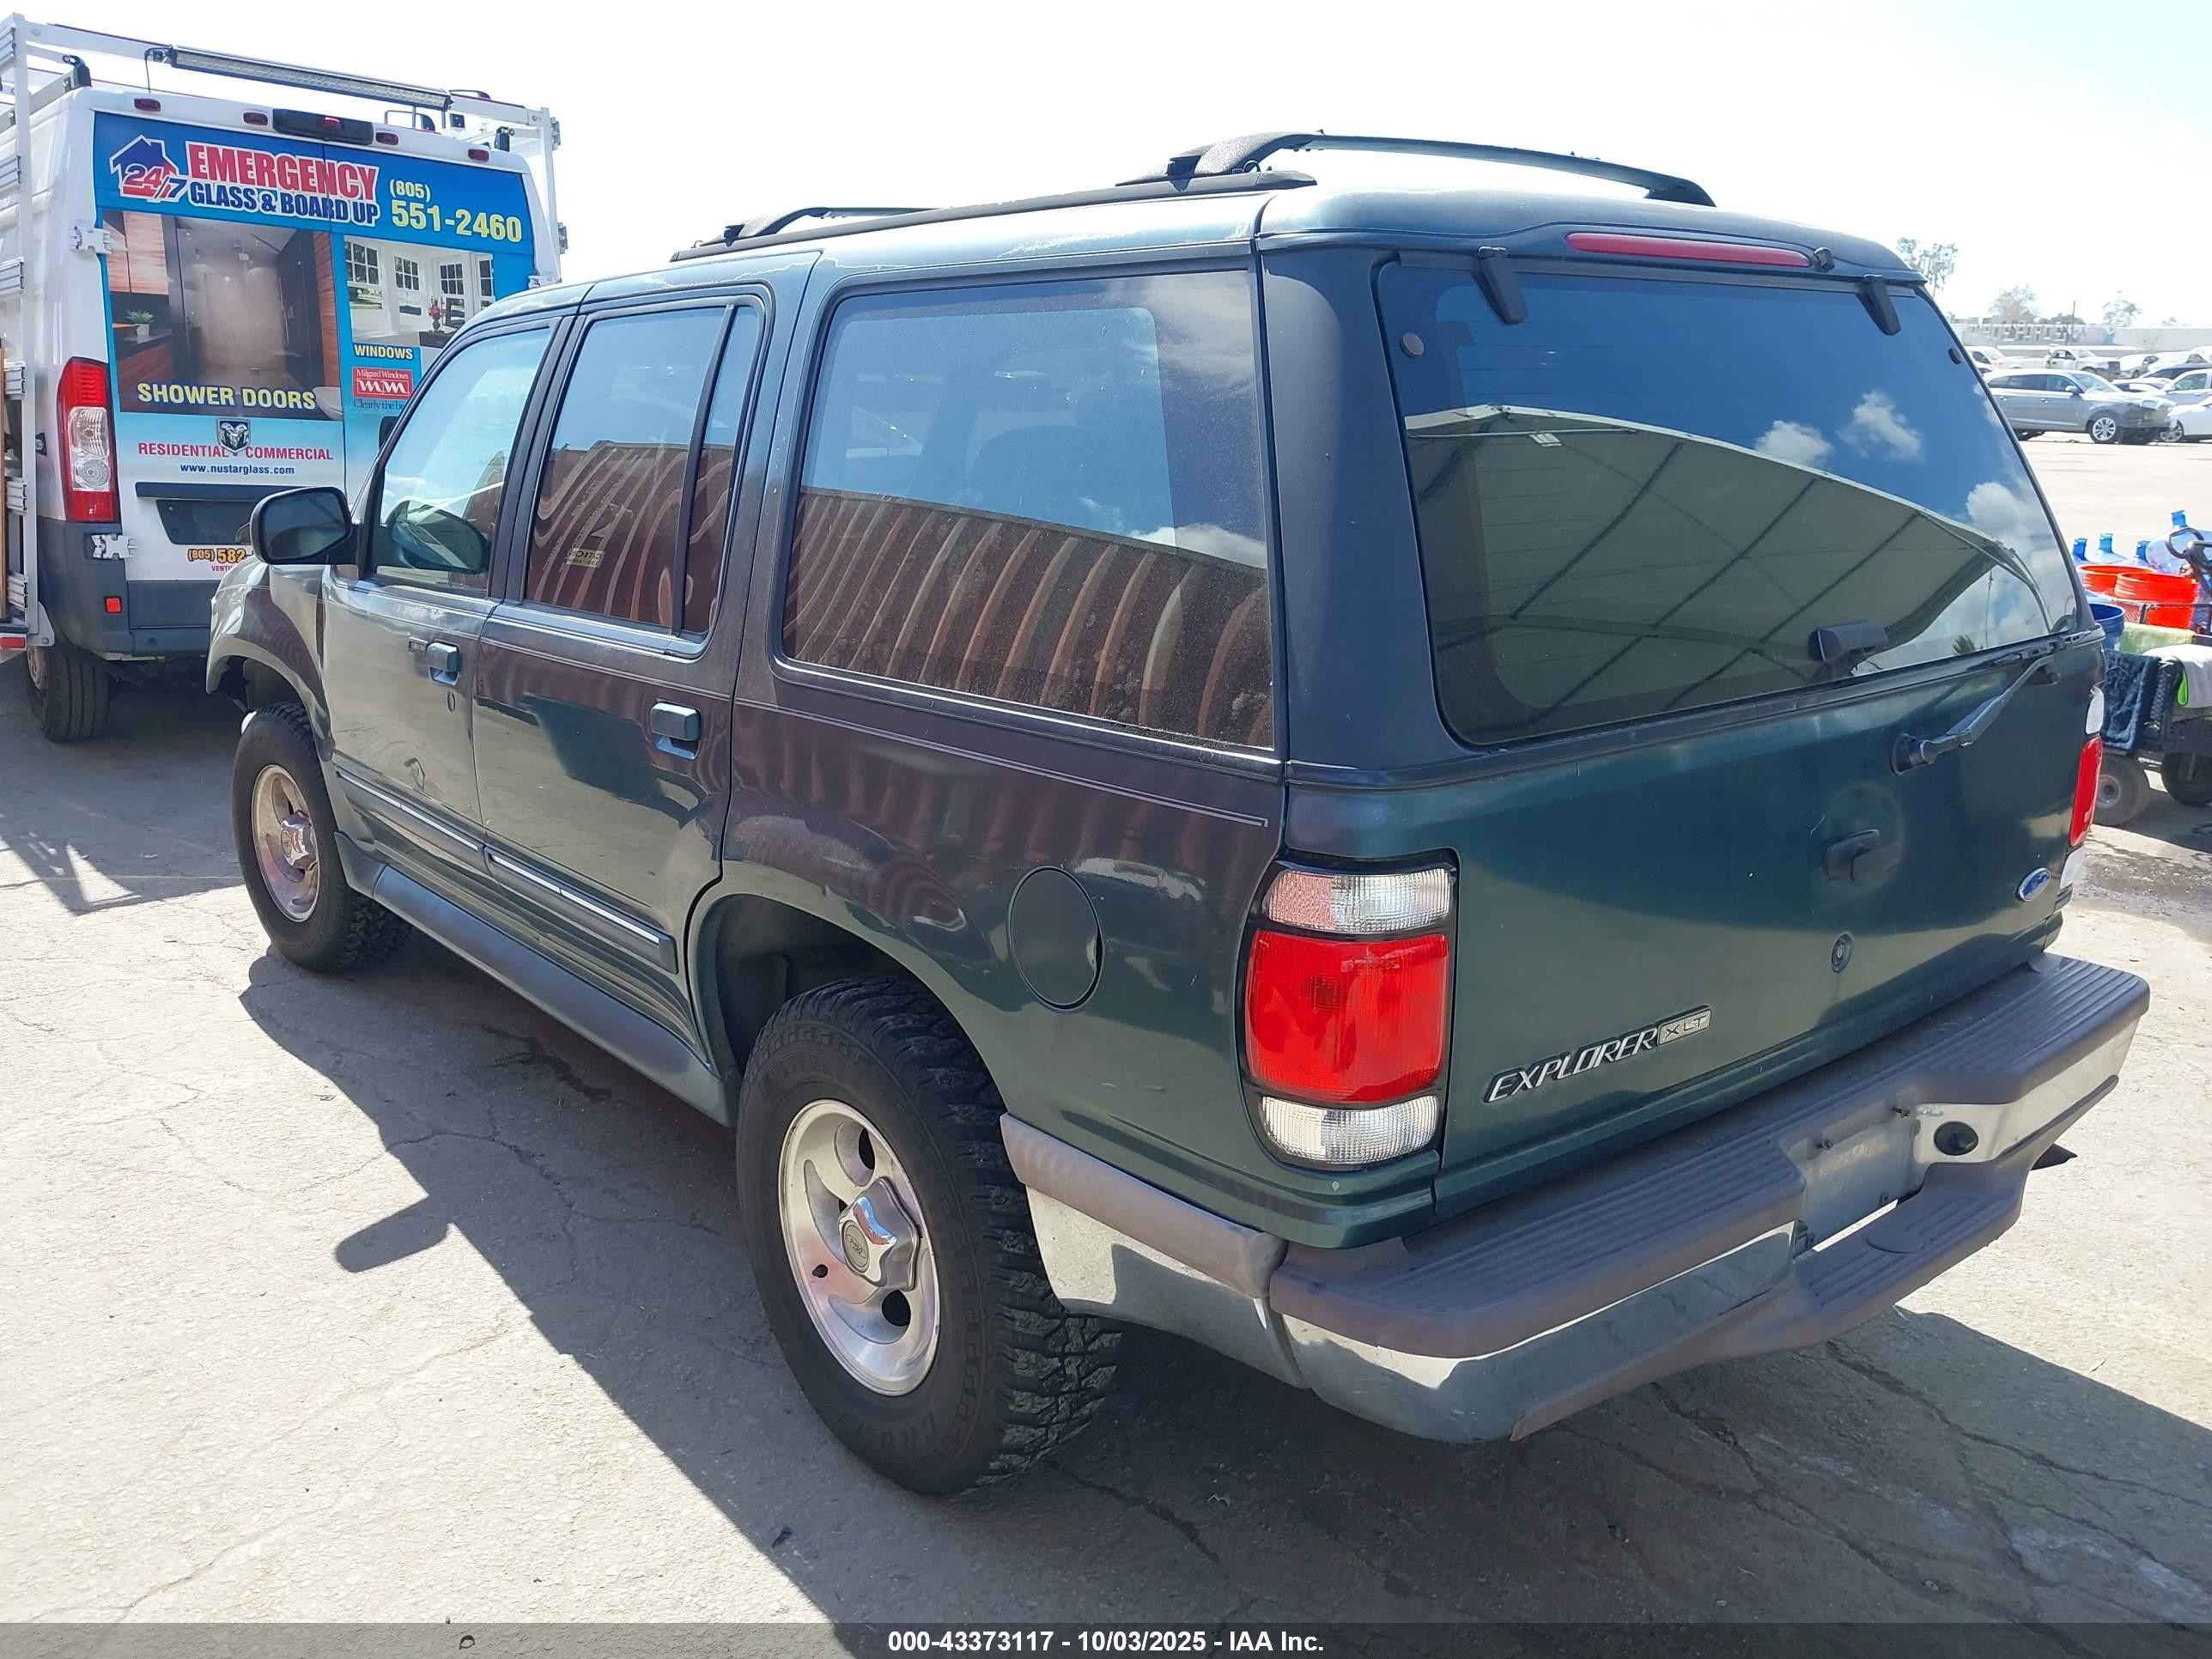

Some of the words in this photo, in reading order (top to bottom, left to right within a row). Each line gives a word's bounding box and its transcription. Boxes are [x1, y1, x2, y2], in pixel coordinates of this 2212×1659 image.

[122, 163, 187, 199] 24/7
[187, 143, 377, 201] EMERGENCY
[190, 181, 257, 210] GLASS
[261, 191, 277, 213] &
[280, 191, 348, 221] BOARD
[349, 200, 379, 224] UP
[390, 179, 430, 203] (805)
[391, 198, 523, 243] 551-2460
[354, 343, 413, 360] WINDOWS
[356, 368, 381, 379] Milgard
[381, 370, 409, 380] Windows
[137, 382, 235, 406] SHOWER
[242, 387, 316, 410] DOORS
[353, 398, 380, 410] Clearly
[138, 442, 229, 458] RESIDENTIAL
[245, 447, 333, 460] COMMERCIAL
[179, 463, 295, 475] www.nustarglass.com
[187, 548, 216, 562] (805)
[1484, 1024, 1658, 1103] EXPLORER
[1665, 1014, 1707, 1039] XLT
